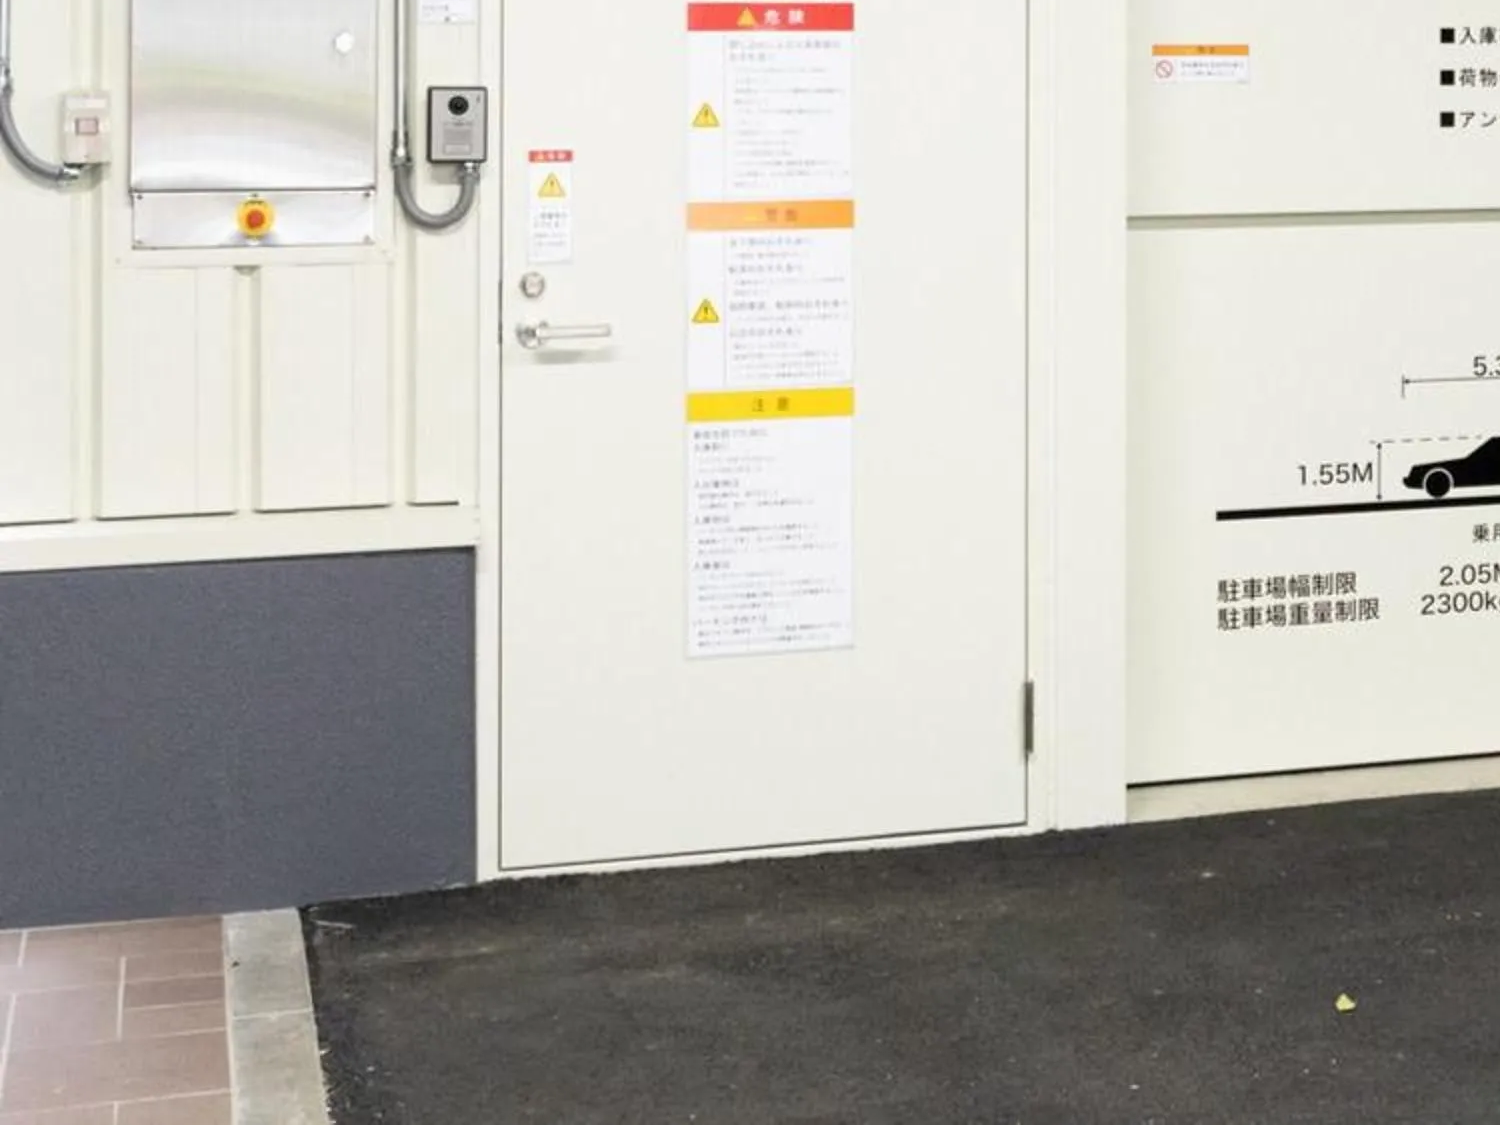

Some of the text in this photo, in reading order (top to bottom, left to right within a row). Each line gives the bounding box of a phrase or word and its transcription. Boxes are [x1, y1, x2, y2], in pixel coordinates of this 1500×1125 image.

[1298, 461, 1373, 486] 1.55M
[1216, 571, 1359, 604] 駐車場幅制限
[1216, 597, 1381, 632] 駐車場重量制限
